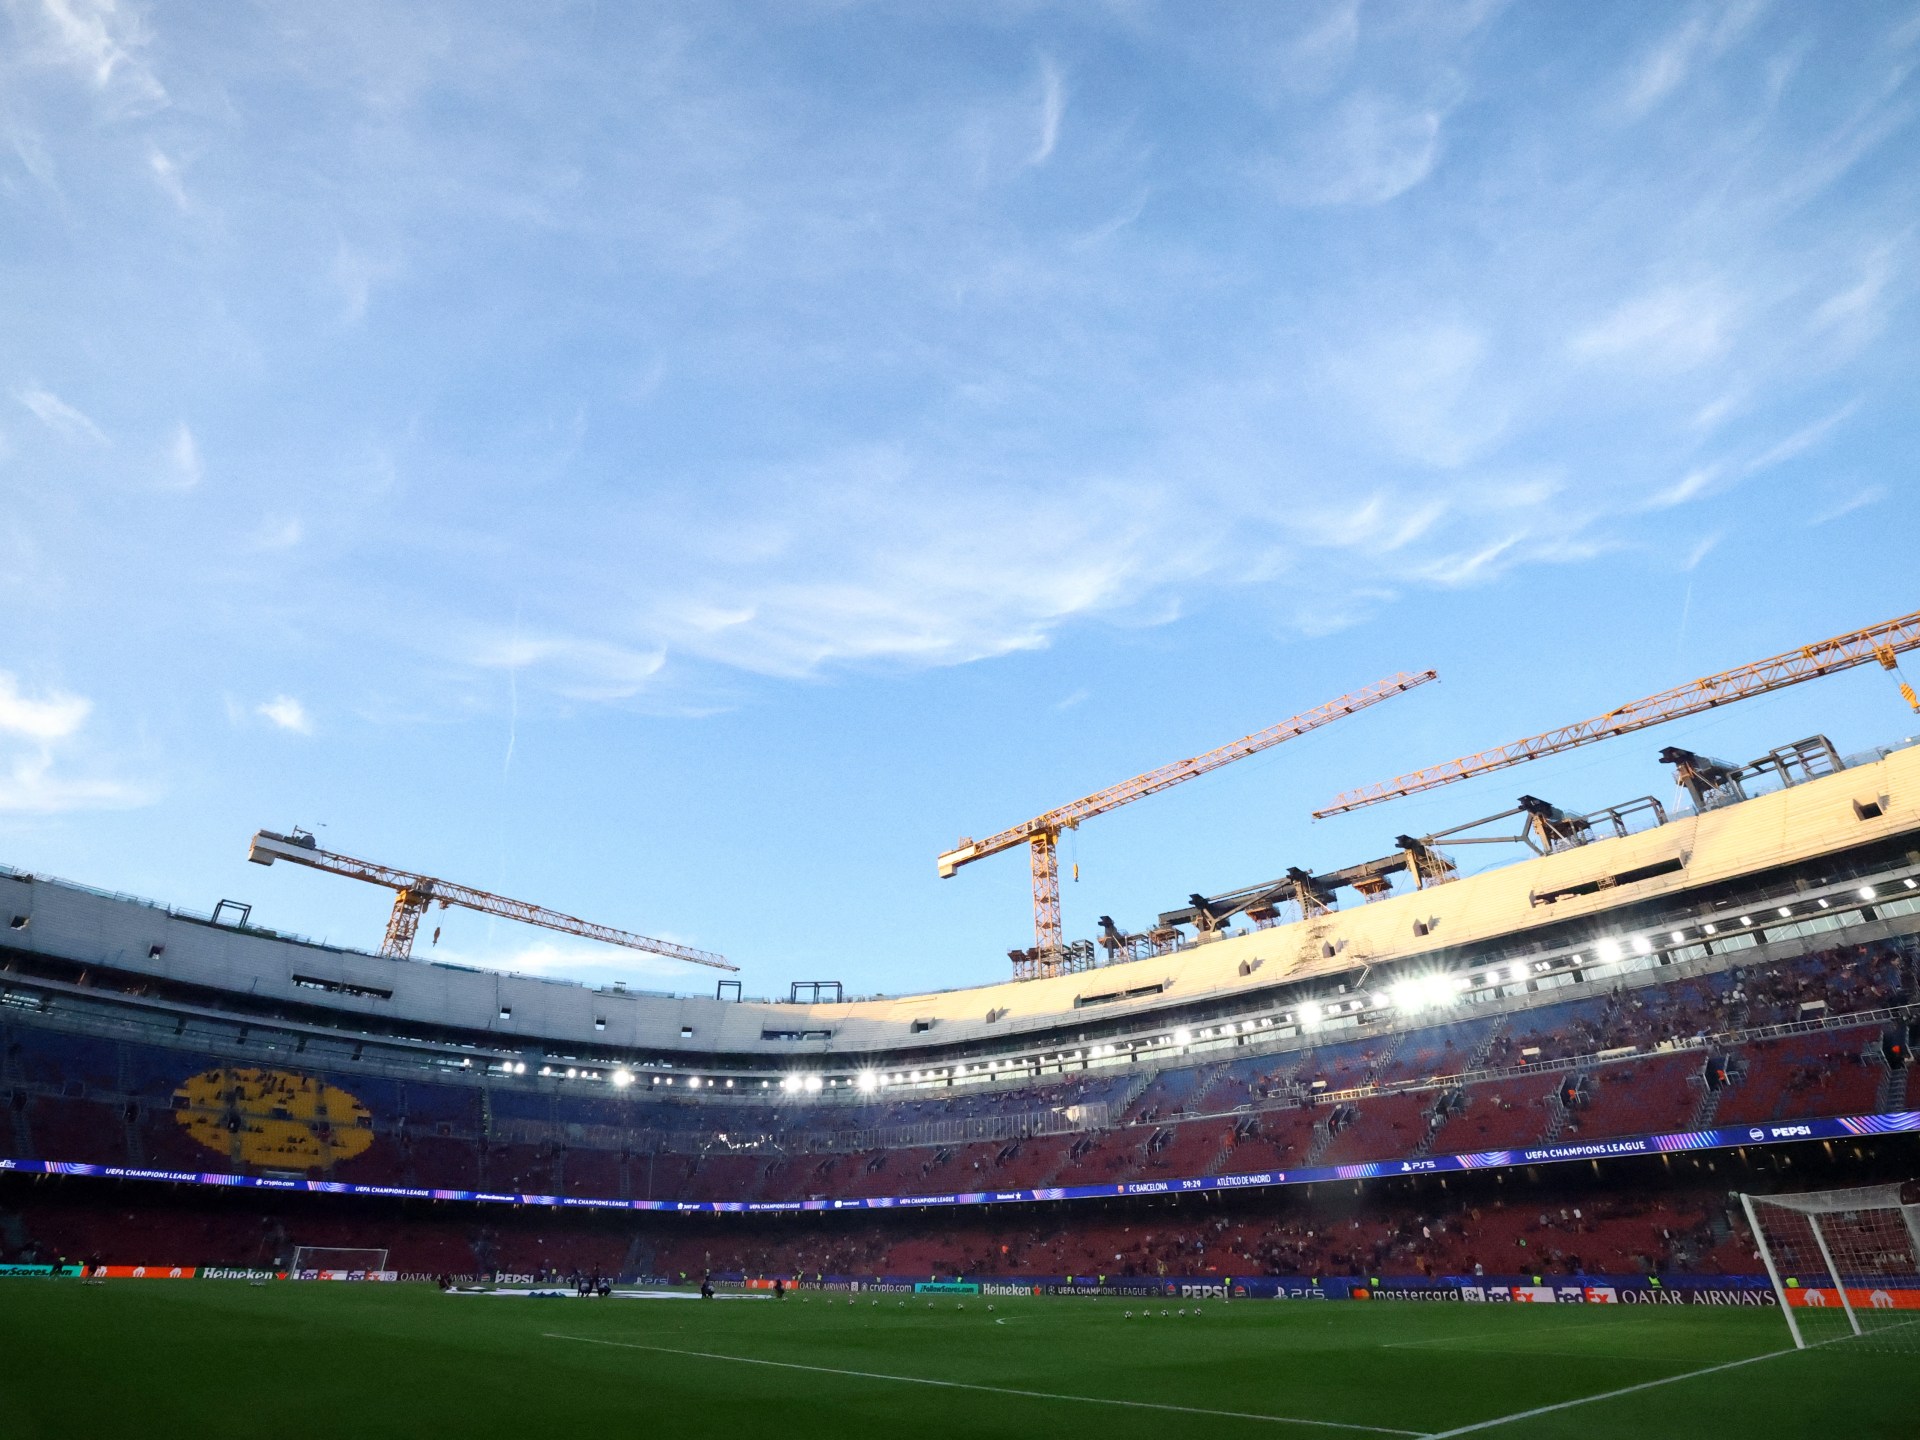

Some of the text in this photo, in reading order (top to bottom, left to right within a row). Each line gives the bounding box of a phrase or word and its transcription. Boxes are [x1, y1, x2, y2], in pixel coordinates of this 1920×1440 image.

[1771, 1126, 1811, 1137] PEPSI
[1525, 1141, 1646, 1160] UEFA CHAMPIONS LEAGUE
[1412, 1161, 1436, 1170] PS5
[125, 1169, 168, 1179] CHAMPIONS
[169, 1173, 196, 1181] LEAGUE
[1217, 1175, 1241, 1186] ATLÉTICO
[1249, 1174, 1271, 1184] MADRID
[1129, 1183, 1168, 1192] FC BARCELONA
[1182, 1180, 1201, 1189] 59:29
[371, 1187, 406, 1195] CHAMPIONS
[203, 1267, 273, 1279] Heineken
[400, 1272, 432, 1281] QATAR
[495, 1273, 534, 1283] PEPSI
[801, 1282, 820, 1290] QATAR
[870, 1284, 911, 1292] crypto.com
[983, 1284, 1031, 1295] Heineken
[1077, 1287, 1116, 1295] CHAMPIONS
[1182, 1286, 1228, 1298] PEPSI
[1291, 1289, 1325, 1299] PS5
[1373, 1289, 1458, 1300] mastercard
[1485, 1287, 1533, 1302] FedEx
[1556, 1288, 1608, 1303] FedEx
[1622, 1290, 1776, 1306] QATAR AIRWAYS
